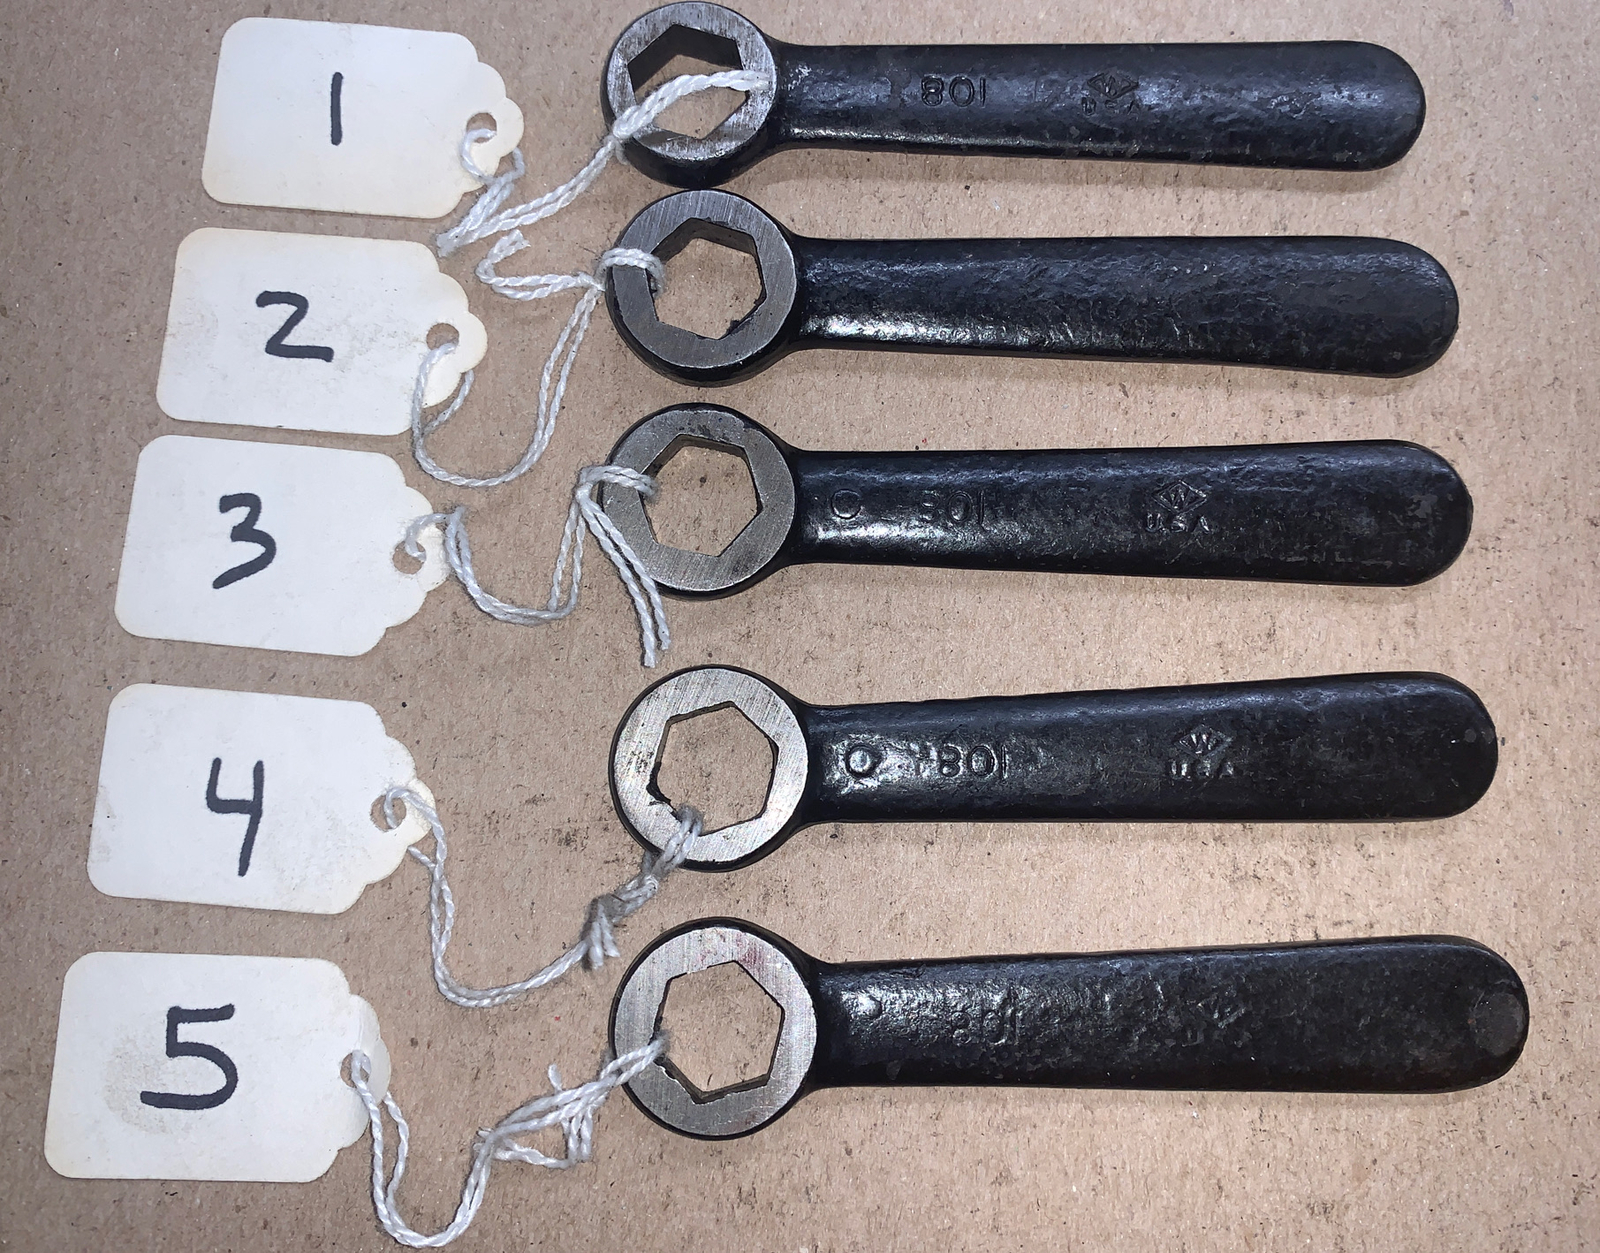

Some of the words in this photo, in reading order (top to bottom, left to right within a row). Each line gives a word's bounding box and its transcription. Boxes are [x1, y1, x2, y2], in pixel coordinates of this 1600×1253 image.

[330, 71, 344, 146] 1
[921, 75, 987, 108] 801
[255, 290, 334, 363] 2
[212, 492, 277, 590] 3
[919, 490, 985, 525] 801
[937, 744, 1008, 778] 801
[205, 757, 264, 877] 4
[139, 1003, 239, 1111] 5
